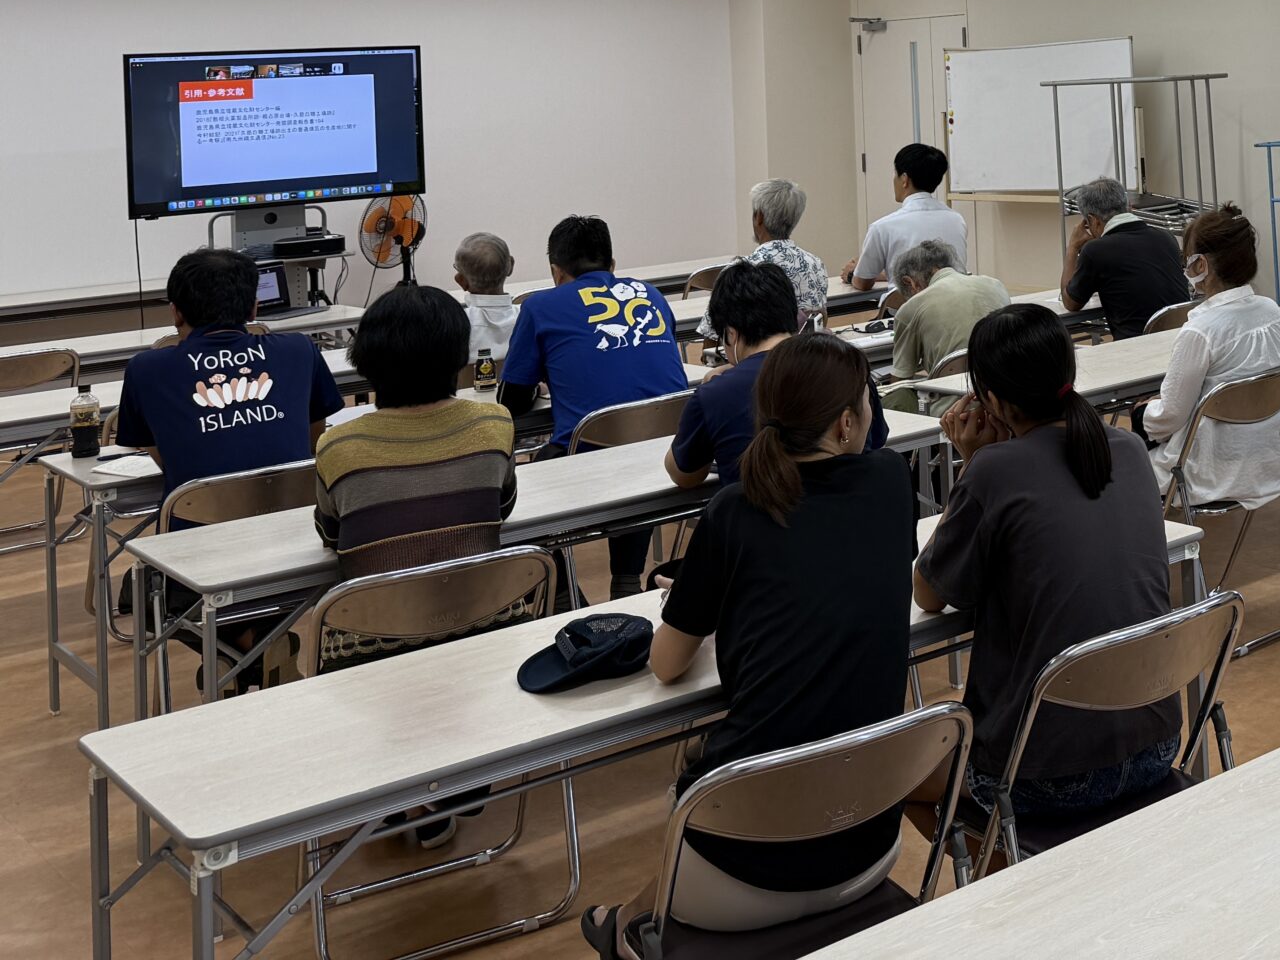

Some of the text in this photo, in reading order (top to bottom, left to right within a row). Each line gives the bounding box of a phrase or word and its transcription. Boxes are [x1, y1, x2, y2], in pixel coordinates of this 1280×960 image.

[184, 87, 245, 98] 引用・参考文献
